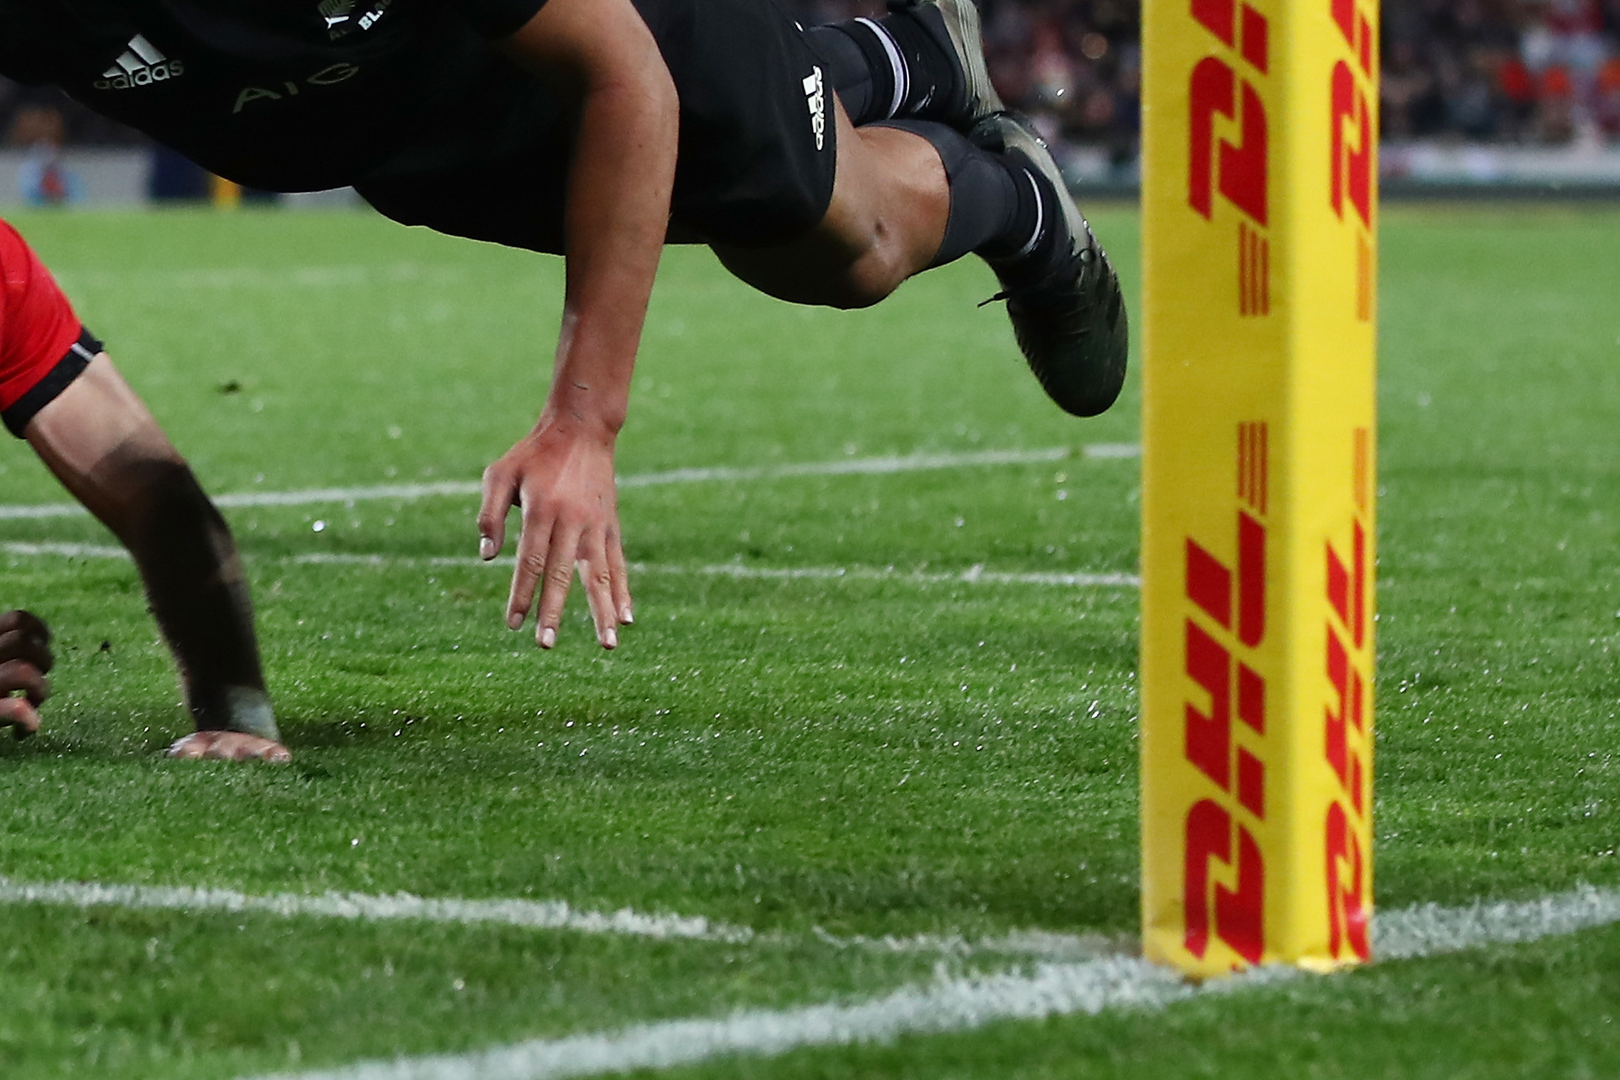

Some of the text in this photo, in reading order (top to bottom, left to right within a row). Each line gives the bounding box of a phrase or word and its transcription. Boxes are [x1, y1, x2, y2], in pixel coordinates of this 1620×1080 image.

[93, 57, 186, 92] adidas
[232, 61, 361, 115] AIG
[810, 65, 826, 151] adidas
[1184, 508, 1266, 966] DHL
[1325, 515, 1369, 964] DHL
